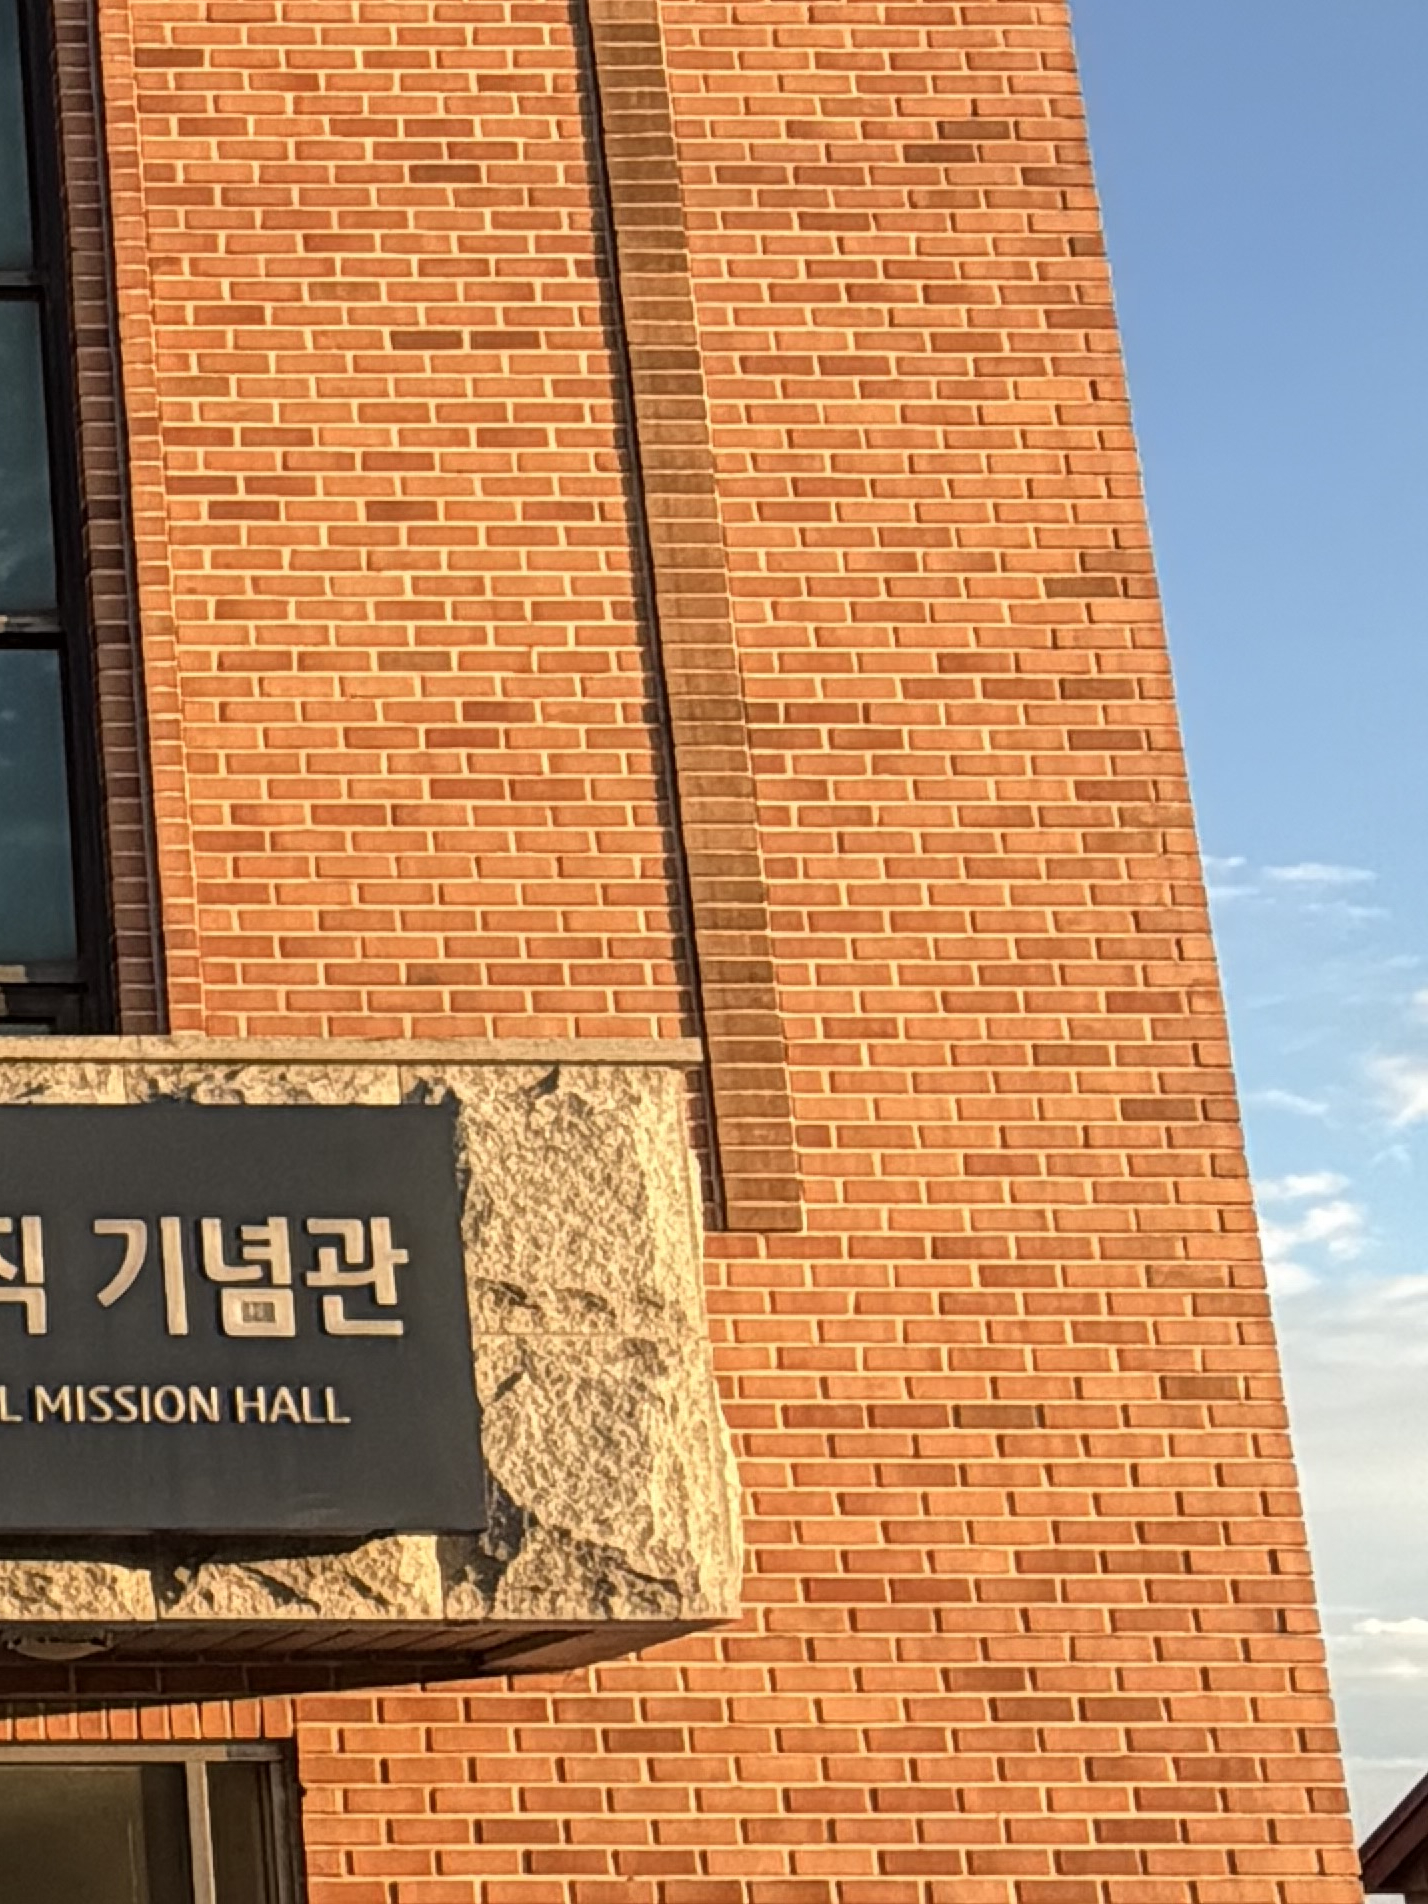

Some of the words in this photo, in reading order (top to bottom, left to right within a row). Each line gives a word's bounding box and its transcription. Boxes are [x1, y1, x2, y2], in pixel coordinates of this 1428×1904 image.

[92, 1215, 411, 1338] 기념관
[34, 1384, 221, 1424] MISSION
[235, 1385, 352, 1425] HALL
